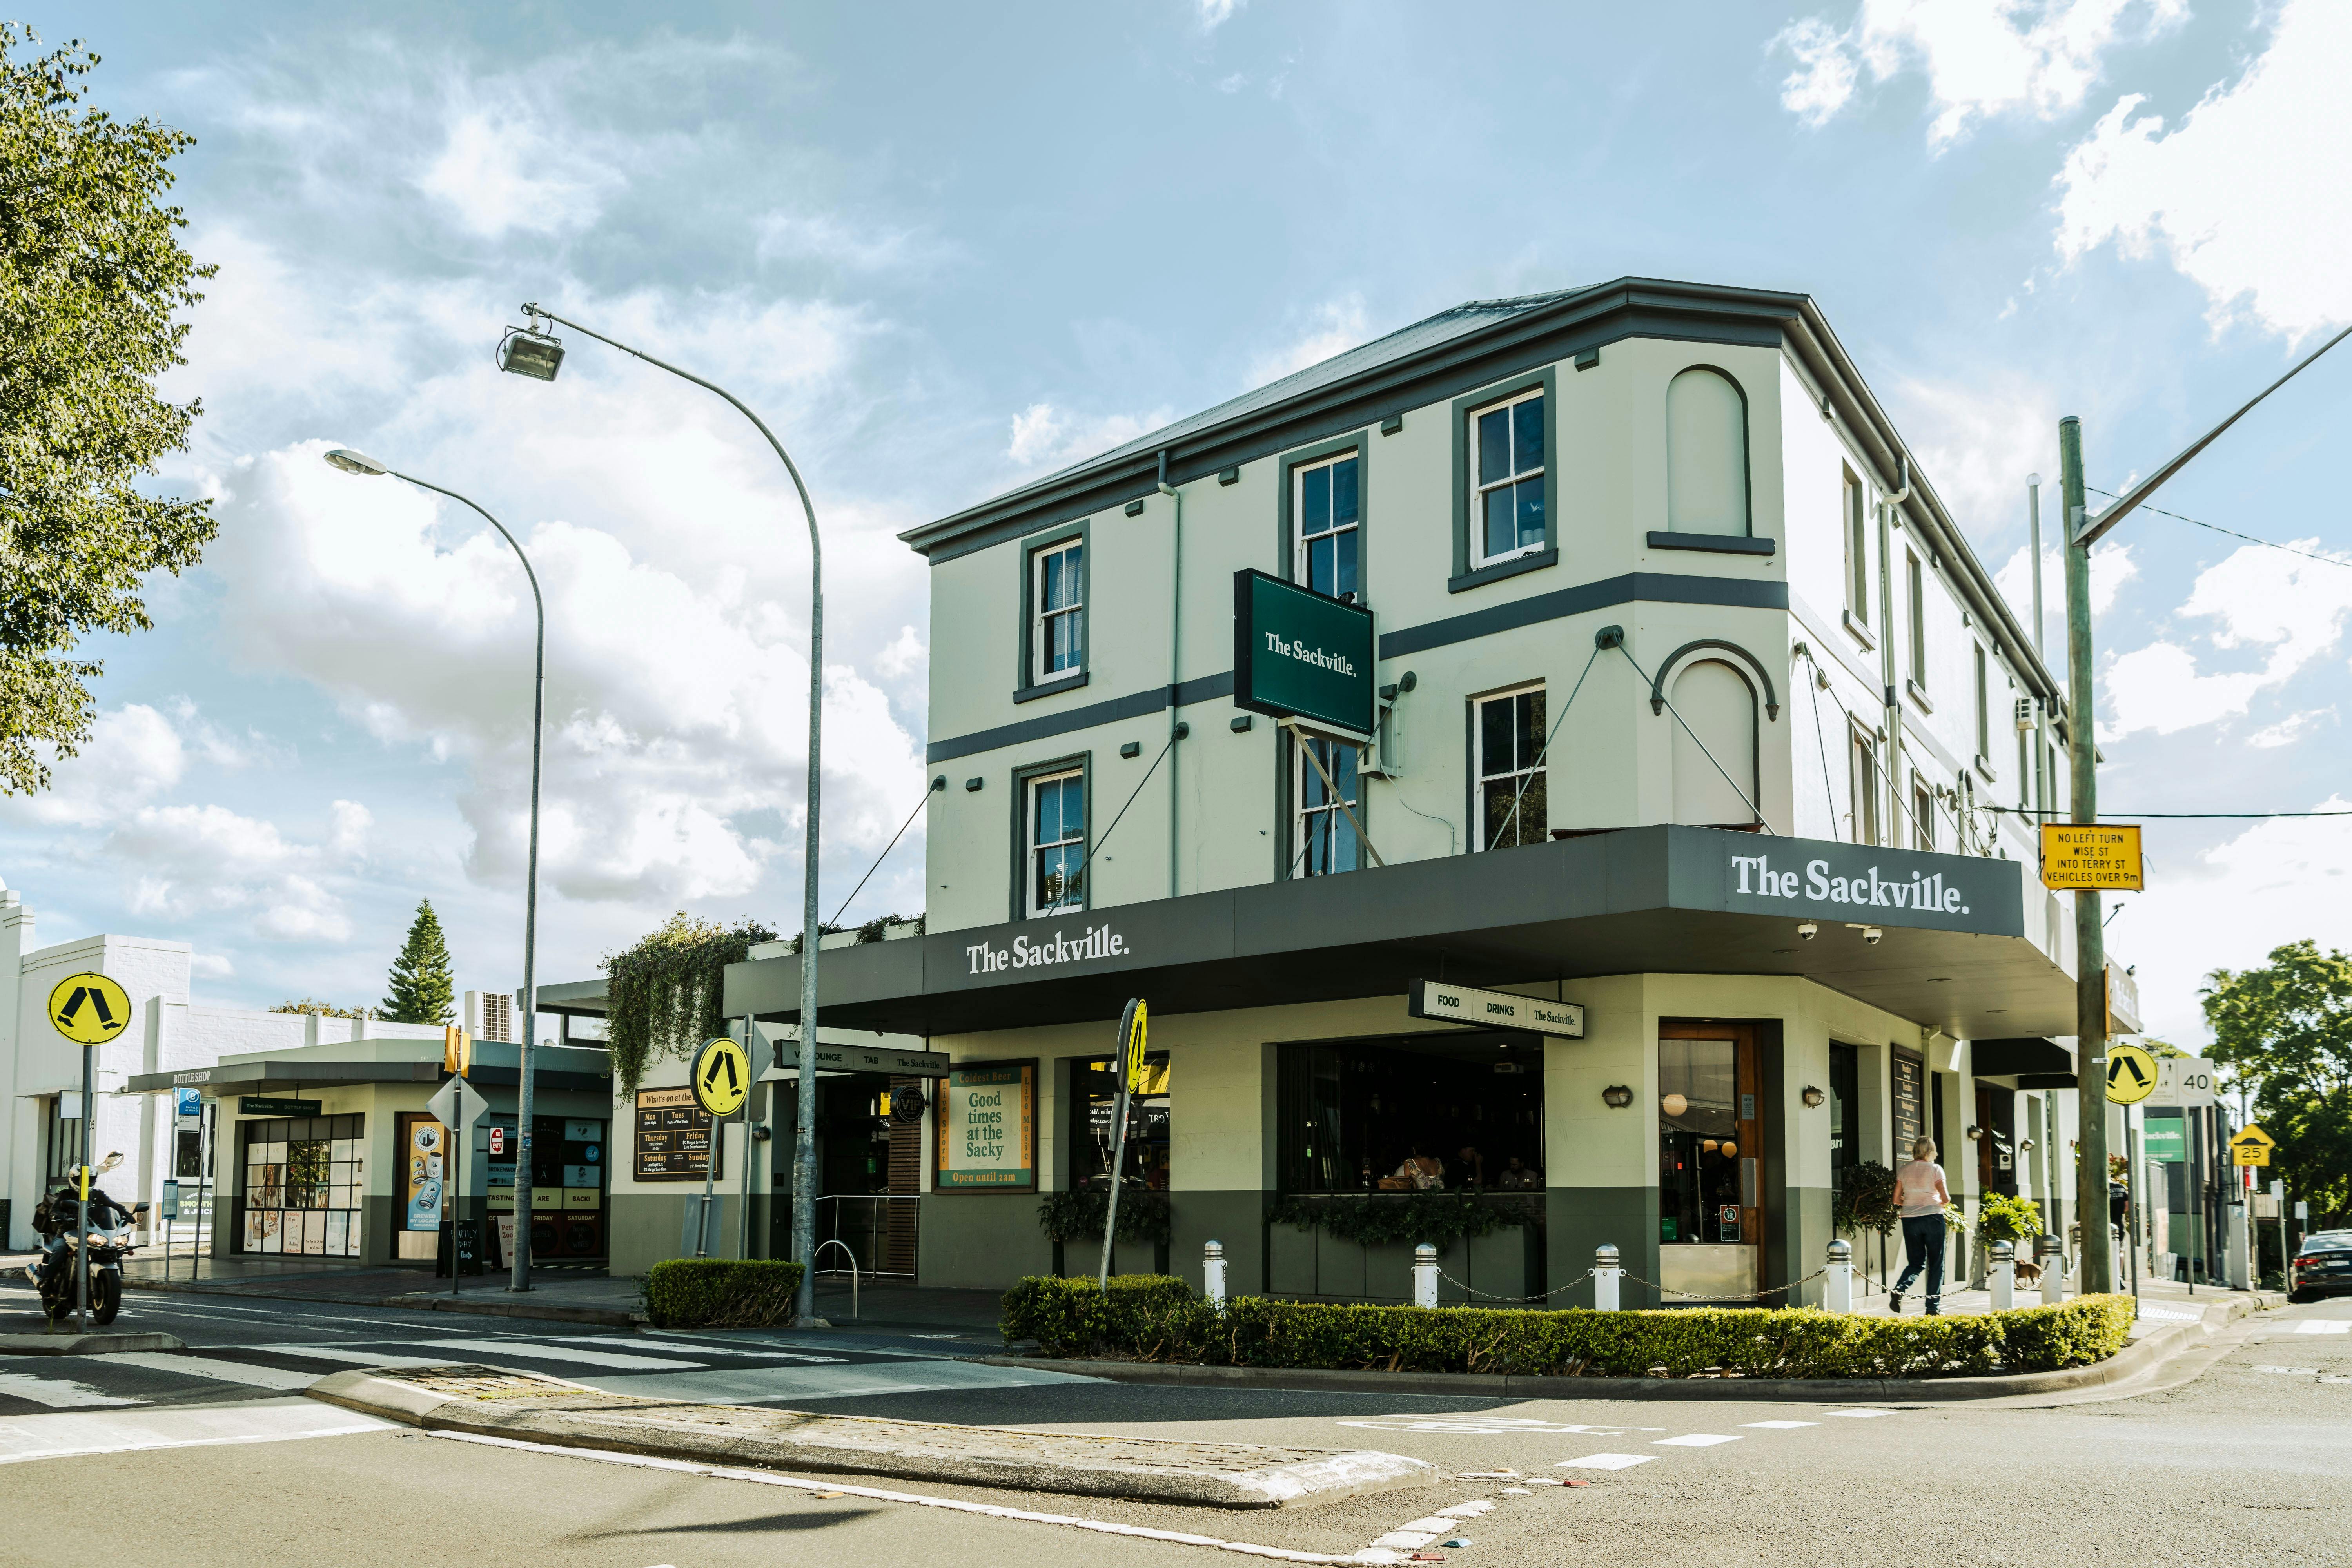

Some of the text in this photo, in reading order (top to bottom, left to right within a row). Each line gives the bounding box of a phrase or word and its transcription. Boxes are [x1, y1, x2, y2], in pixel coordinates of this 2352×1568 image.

[1265, 632, 1356, 677] The Sackville.
[2058, 834, 2123, 843] NO LEFT TURN
[2073, 847, 2109, 856] WISE ST
[2057, 859, 2125, 869] INTO TERRY ST
[2047, 872, 2138, 882] VEHICLES OVER 9m
[1731, 855, 1970, 915] The Sackville.
[967, 924, 1129, 974] The Sackville.
[1438, 995, 1460, 1007] FOOD
[1487, 1002, 1514, 1016] DRINKS
[1534, 1010, 1576, 1025] The Sackville.
[815, 1052, 842, 1062] OUNGE
[864, 1056, 878, 1064] TAB
[897, 1058, 941, 1069] The Sackville.
[174, 1071, 211, 1084] BOTTLE SHOP
[959, 1072, 1011, 1083] Coldest Beer
[2184, 1074, 2208, 1089] 40
[646, 1094, 665, 1103] What's
[682, 1093, 691, 1101] the
[969, 1090, 1002, 1108] Good
[901, 1099, 920, 1110] VIP
[968, 1109, 1002, 1124] times
[645, 1134, 668, 1142] Thursday
[686, 1132, 705, 1140] Friday
[967, 1124, 1002, 1141] at the
[966, 1141, 1004, 1161] Sacky
[2242, 1148, 2261, 1158] 25
[644, 1154, 667, 1163] Saturday
[689, 1153, 709, 1161] Sunday
[953, 1172, 1016, 1184] Open until 2am
[2233, 1207, 2241, 1216] P
